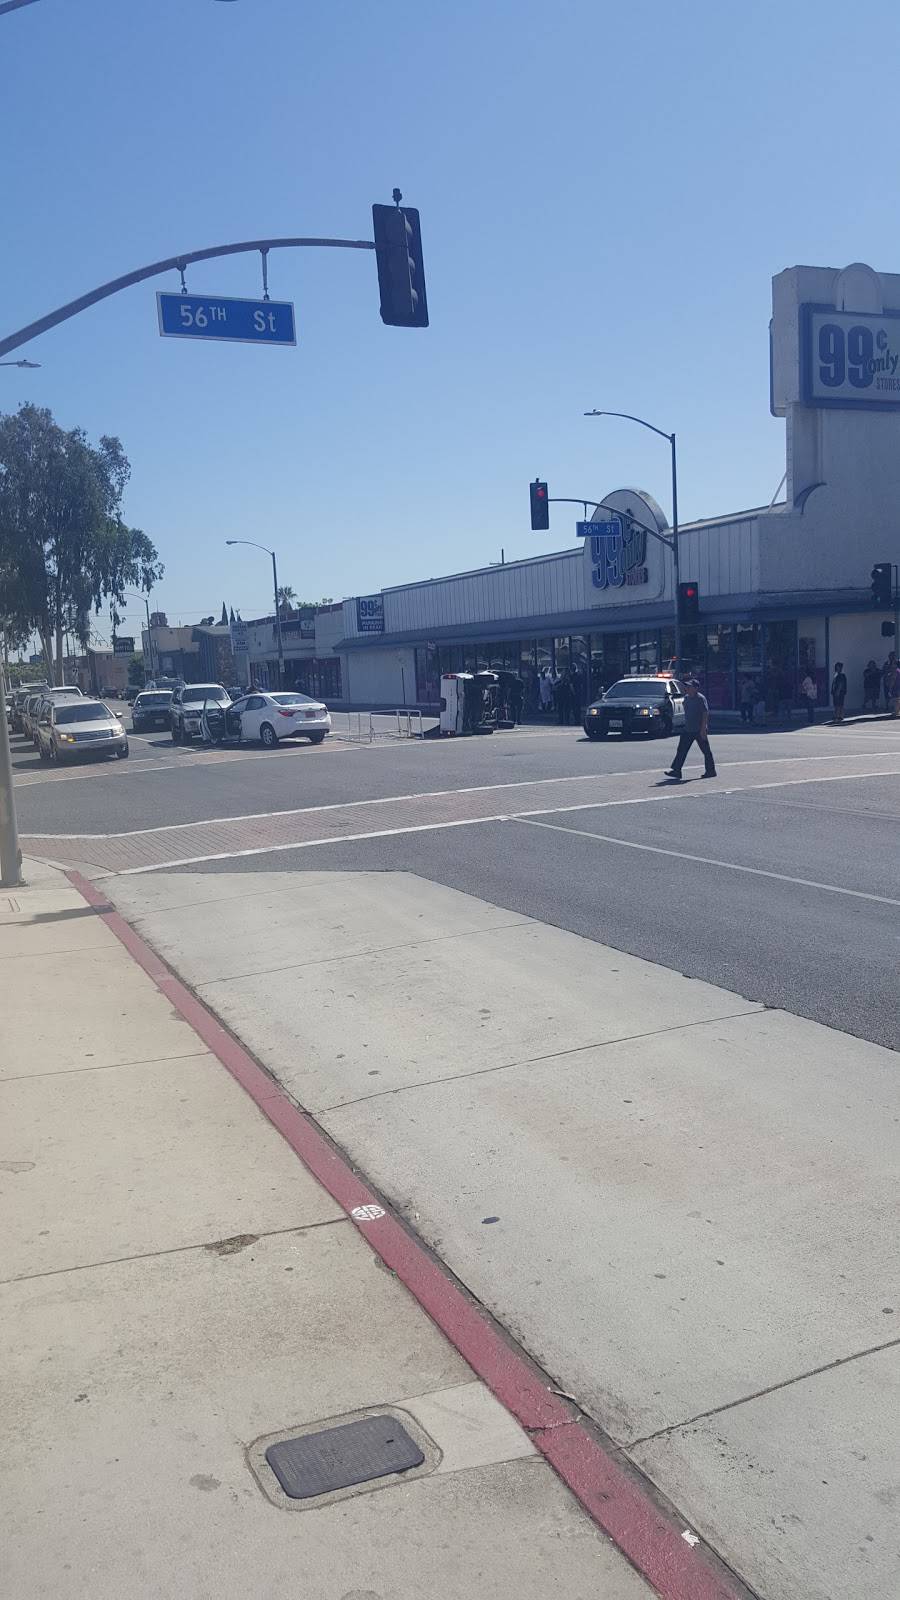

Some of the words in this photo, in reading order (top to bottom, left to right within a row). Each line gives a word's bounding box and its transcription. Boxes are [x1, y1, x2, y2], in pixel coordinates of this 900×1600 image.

[180, 304, 227, 328] 56TH
[253, 310, 277, 332] St
[583, 524, 599, 534] 56TH
[606, 524, 615, 534] St
